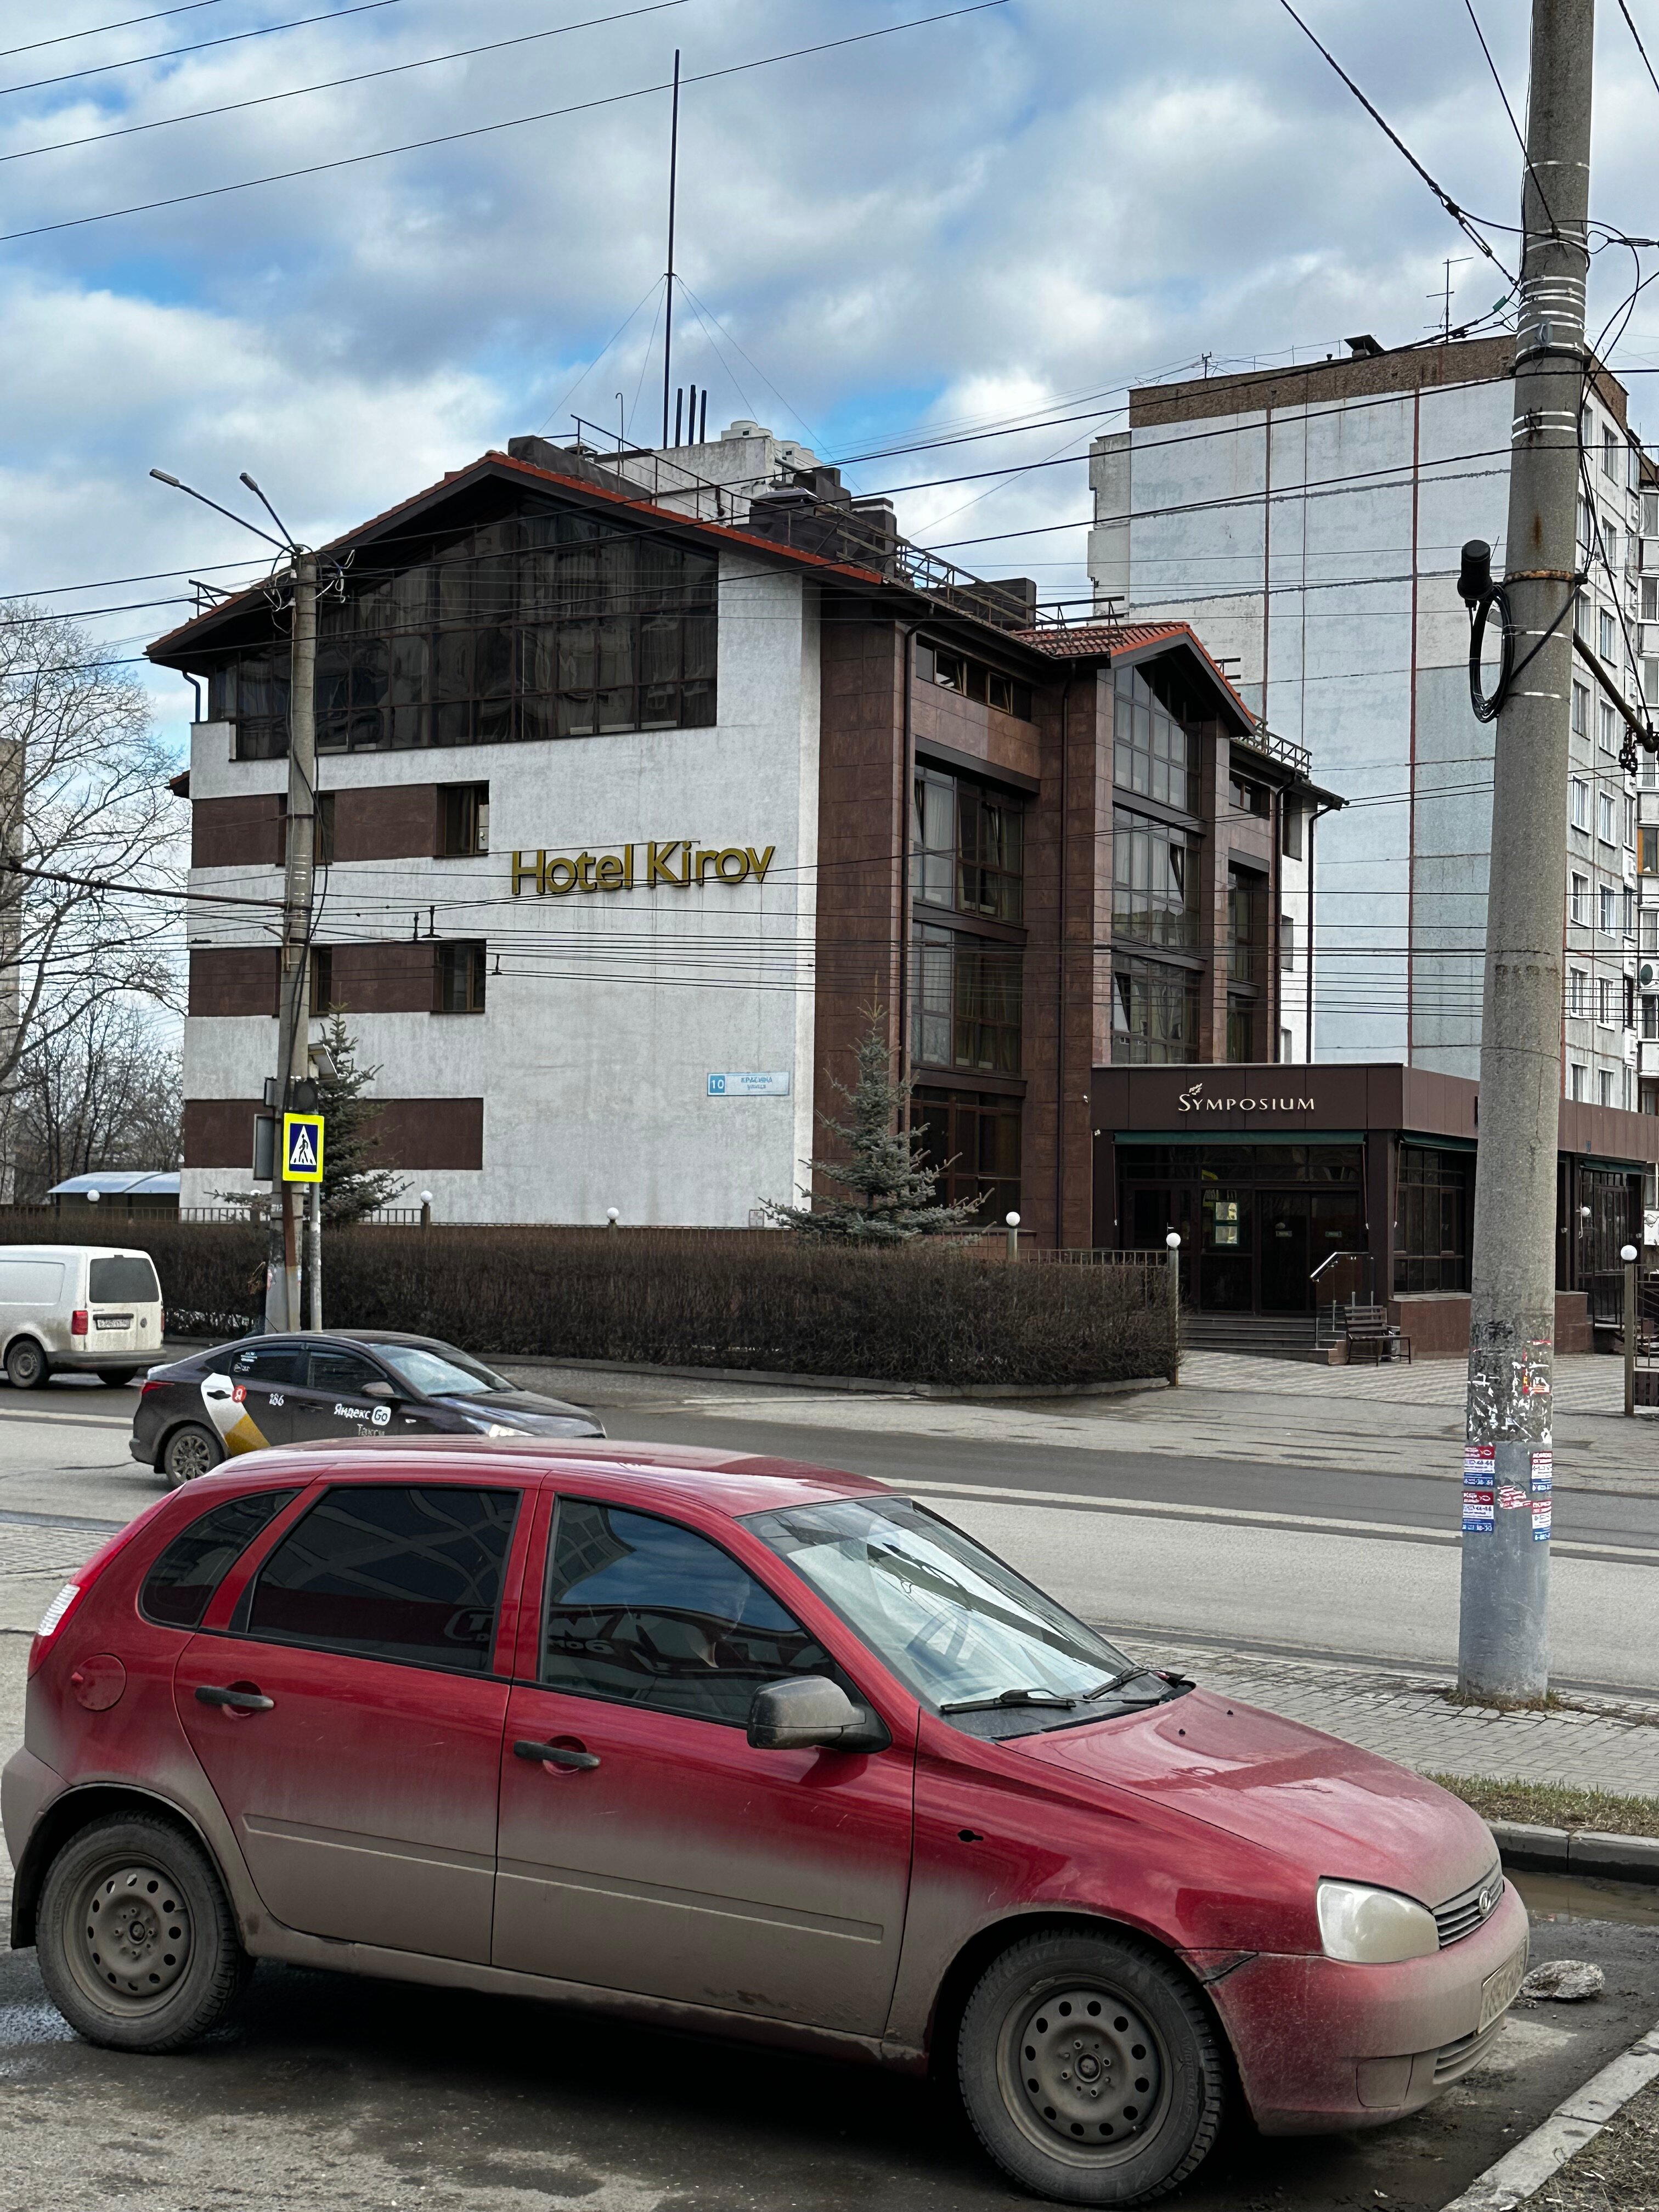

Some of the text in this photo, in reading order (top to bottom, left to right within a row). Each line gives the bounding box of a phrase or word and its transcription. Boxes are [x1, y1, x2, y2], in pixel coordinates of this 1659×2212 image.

[511, 840, 776, 895] Hotel Kirov
[712, 1079, 724, 1089] 10
[1178, 1093, 1315, 1111] SYMPOSIUM
[235, 1389, 243, 1401] Я
[334, 1403, 388, 1422] Яндекс Go
